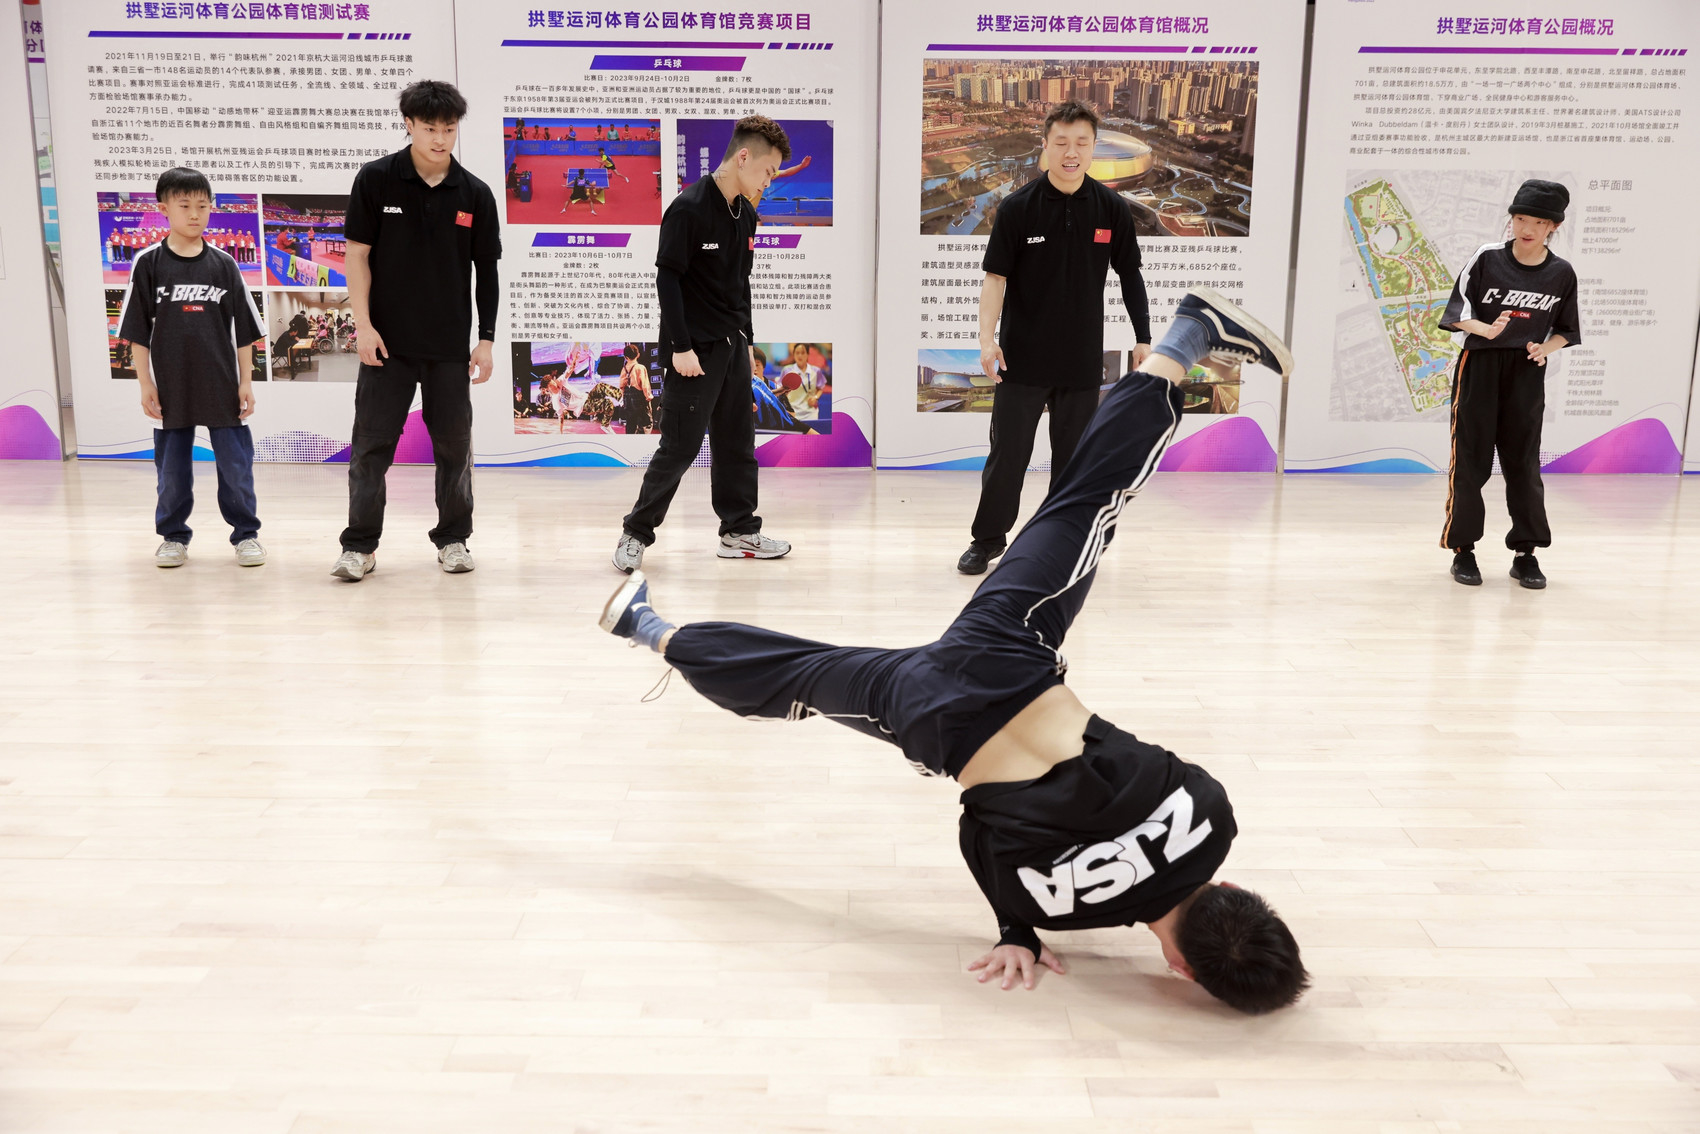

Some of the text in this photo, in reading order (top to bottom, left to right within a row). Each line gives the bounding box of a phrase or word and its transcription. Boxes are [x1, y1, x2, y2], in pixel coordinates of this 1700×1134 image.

[125, 2, 371, 21] 拱墅运河体育公园体育馆测试赛
[527, 10, 811, 31] 拱墅运河体育公园体育馆竞赛项目
[976, 14, 1210, 34] 拱墅运河体育公园体育馆概况
[1436, 17, 1615, 36] 拱墅运河体育公园概况
[653, 58, 683, 69] 乒乓球
[89, 92, 193, 102] 方面检验场馆赛事承办能力。
[1351, 120, 1373, 128] Winka
[92, 132, 155, 142] 验场馆办赛能力。
[1588, 179, 1633, 191] 总平面图
[383, 206, 403, 214] ZJSA
[1026, 235, 1046, 244] ZJSA
[701, 242, 720, 250] ZJSA
[937, 243, 988, 252] 拱墅运河体育
[921, 261, 983, 270] 建筑造型灵感源
[1482, 288, 1561, 312] C-BREAK
[1017, 785, 1213, 918] ZJSA
